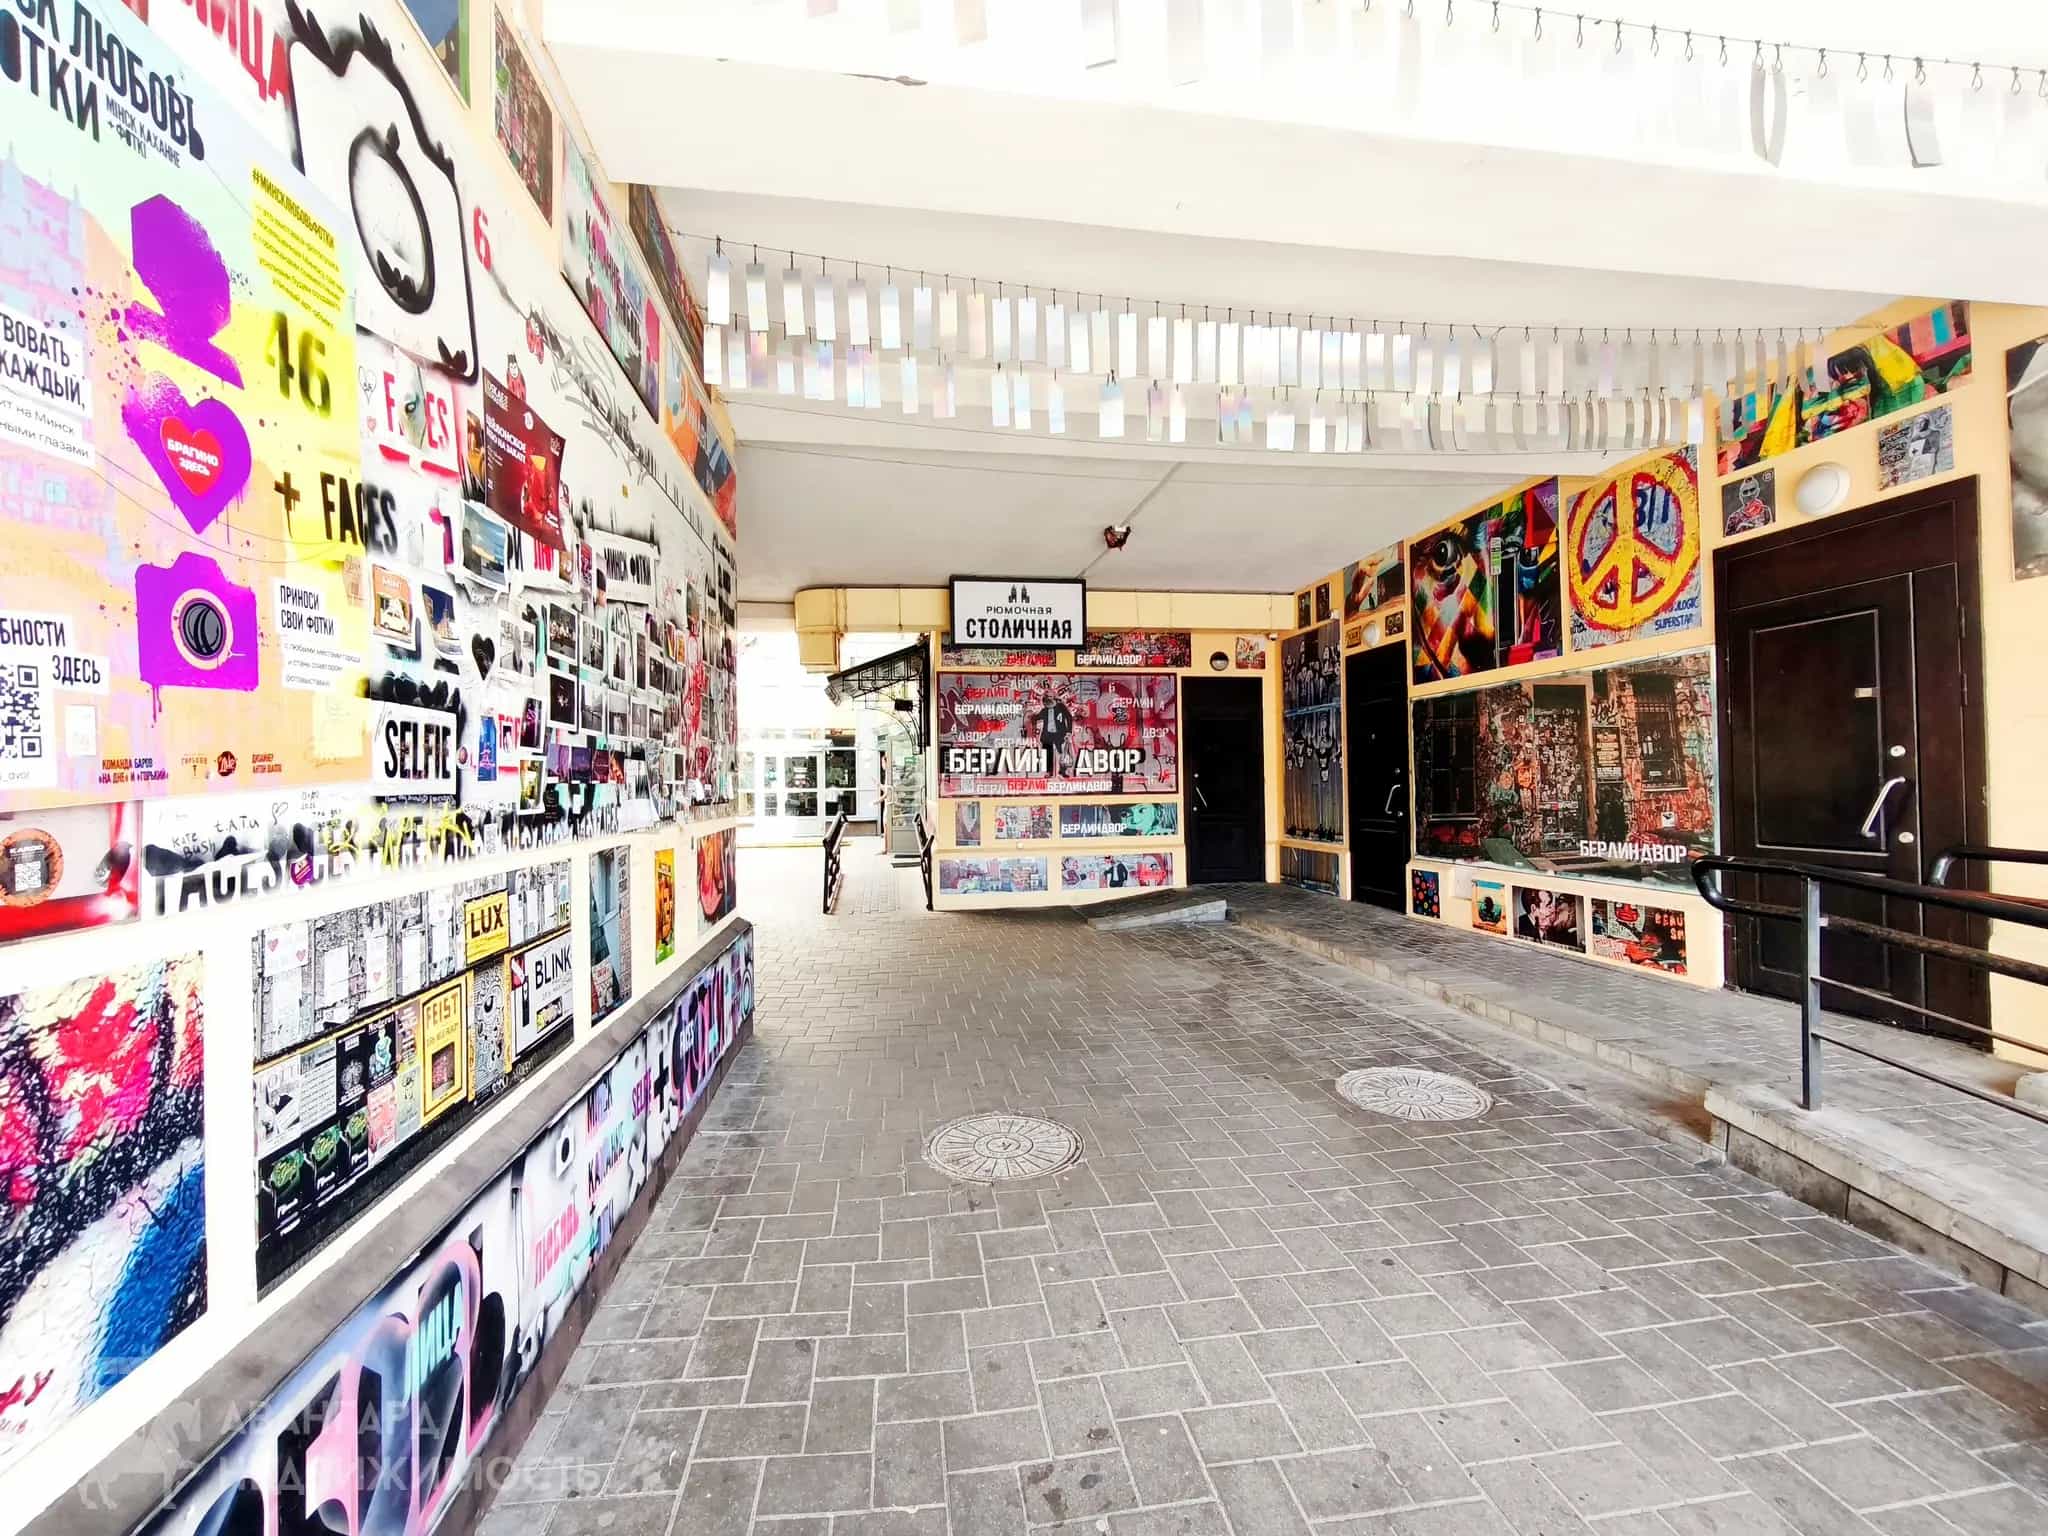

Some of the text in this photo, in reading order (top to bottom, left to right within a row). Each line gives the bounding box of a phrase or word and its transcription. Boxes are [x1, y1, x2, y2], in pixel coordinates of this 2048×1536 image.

[70, 0, 205, 161] ЛЮБОВЬ
[265, 311, 332, 420] 46
[16, 406, 32, 419] на
[34, 410, 75, 434] Минск
[39, 433, 90, 459] глазами
[319, 470, 400, 556] FACES
[279, 584, 321, 612] ПРИНОСИ
[280, 608, 336, 637] СВОИ ФОТКИ
[965, 617, 1073, 640] СТОЛИЧНАЯ
[52, 654, 101, 687] ЗДЕСЬ
[1077, 653, 1143, 666] БЕРЛИНДВОР
[954, 703, 1024, 715] БЕРЛИНДВОР
[384, 718, 452, 780] SELFIE
[948, 748, 1142, 777] БЕРЛИН ДВОР
[1061, 823, 1128, 835] БЕРЛИНДВОР
[1579, 839, 1687, 864] БЕРЛИНДВОР
[470, 903, 505, 938] LUX
[534, 944, 572, 990] BLINK
[426, 993, 459, 1029] FEIST
